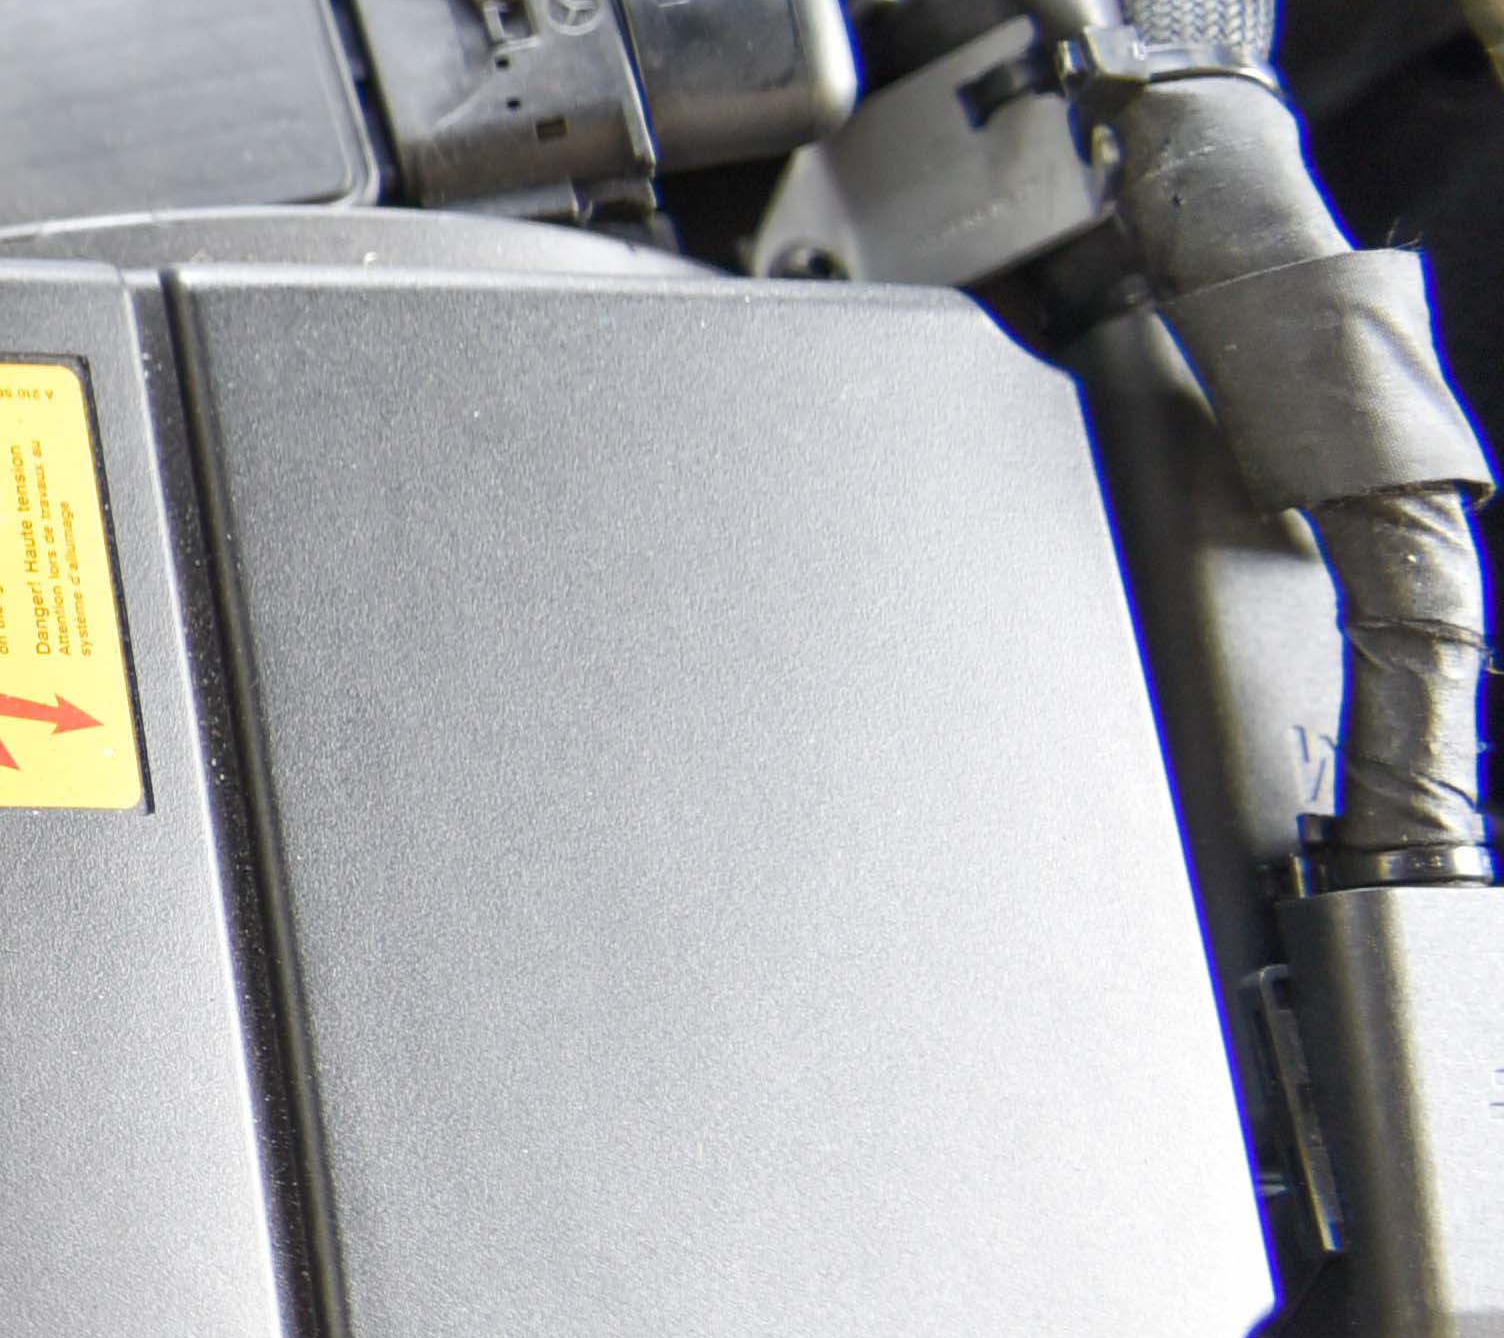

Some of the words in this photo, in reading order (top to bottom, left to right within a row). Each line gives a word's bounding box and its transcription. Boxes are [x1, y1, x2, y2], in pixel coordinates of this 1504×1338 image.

[11, 445, 30, 511] tension
[36, 464, 50, 519] travaux
[21, 520, 39, 573] Haute
[44, 525, 54, 543] de
[48, 550, 59, 579] lors
[27, 581, 51, 655] Danger!
[53, 585, 71, 655] Attention
